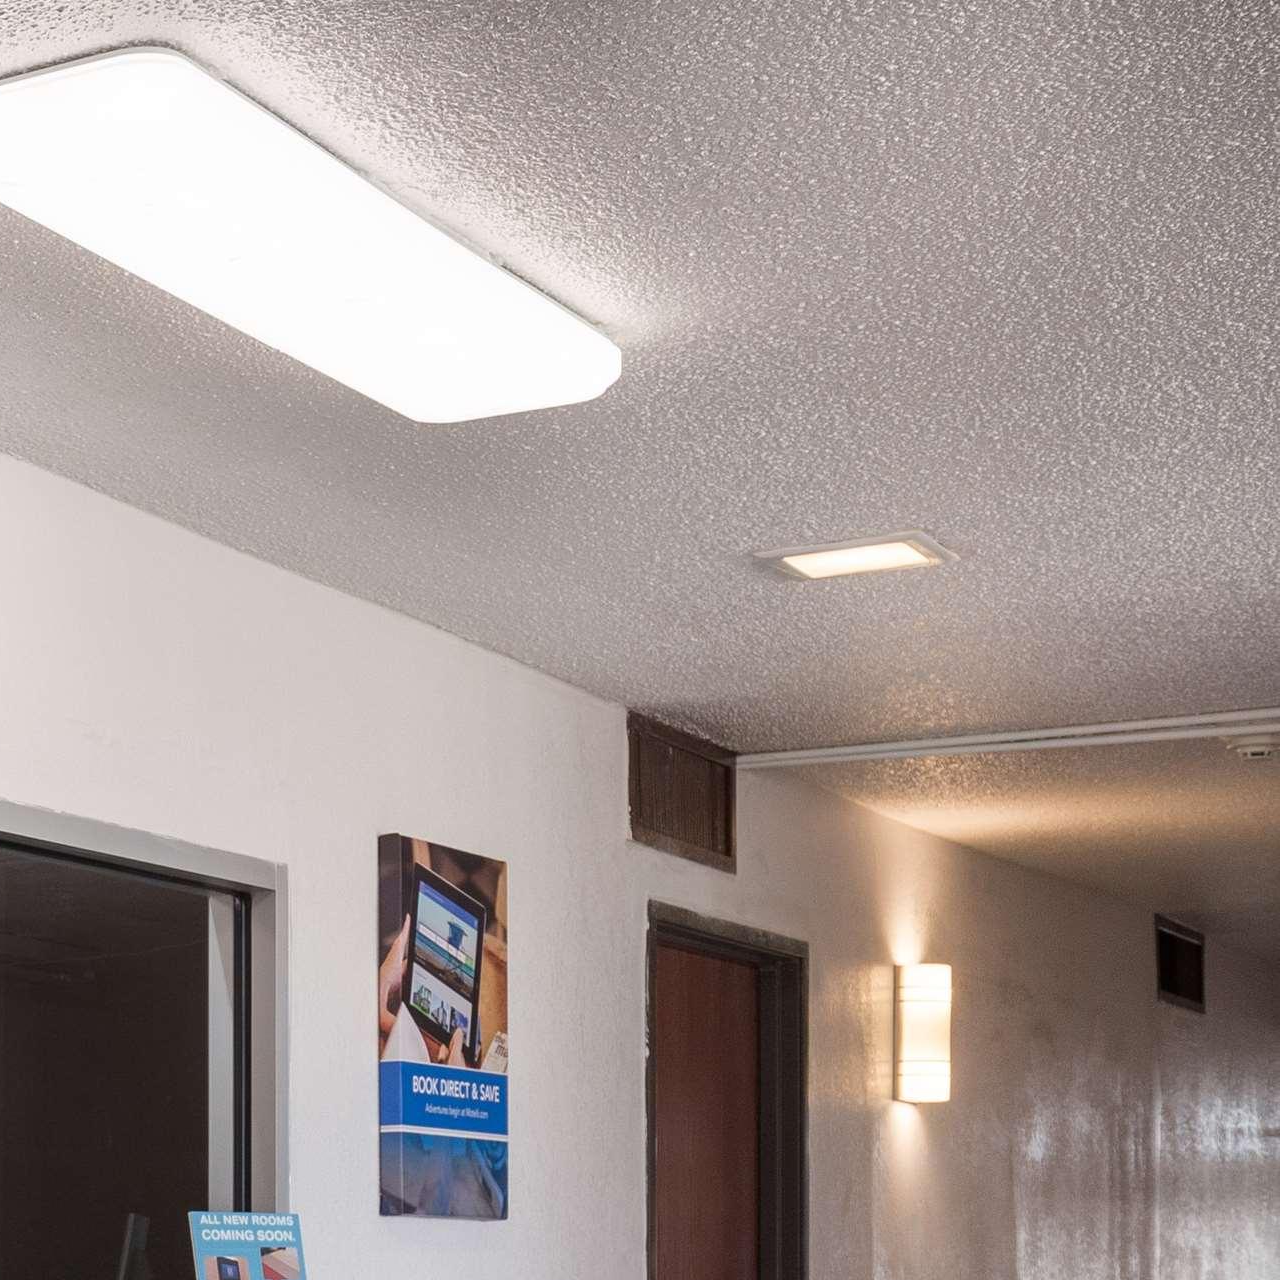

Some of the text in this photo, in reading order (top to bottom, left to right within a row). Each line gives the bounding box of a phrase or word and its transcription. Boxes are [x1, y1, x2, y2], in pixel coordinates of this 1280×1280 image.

[412, 1075, 500, 1103] BOOK DIRECT & SAVE
[200, 1215, 294, 1227] ALL NEW ROOMS
[201, 1229, 296, 1242] COMING SOON.
